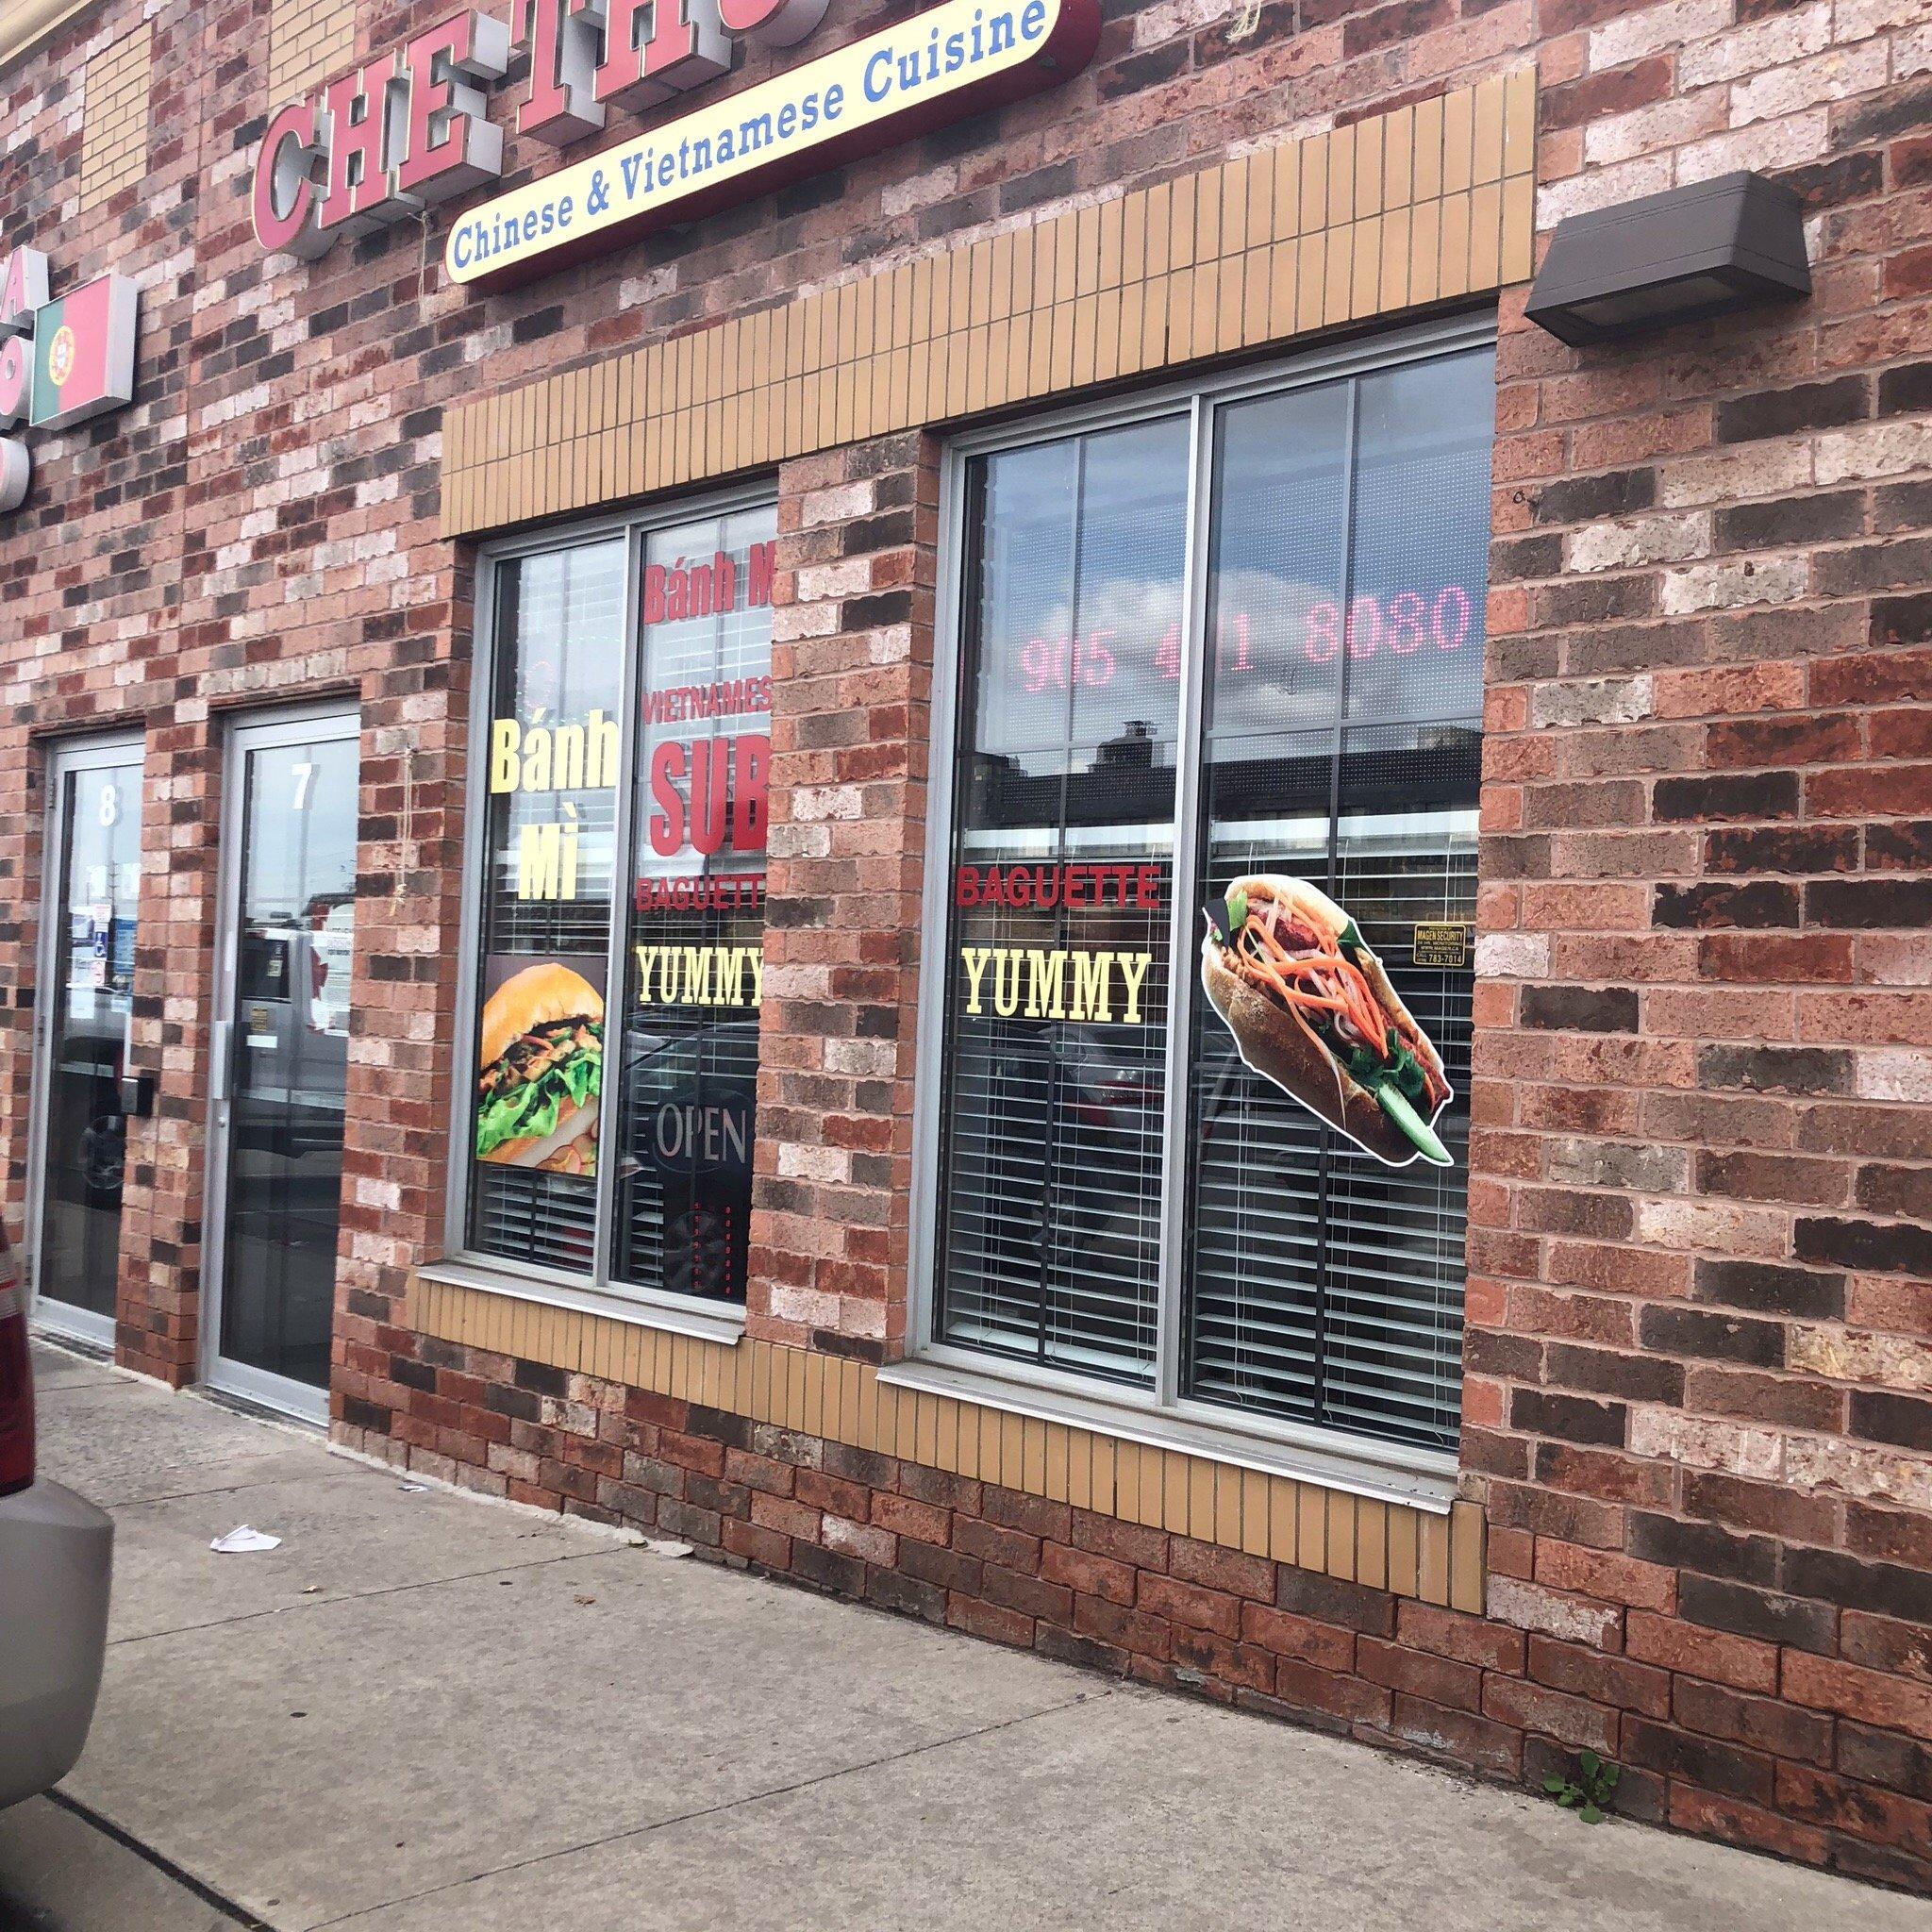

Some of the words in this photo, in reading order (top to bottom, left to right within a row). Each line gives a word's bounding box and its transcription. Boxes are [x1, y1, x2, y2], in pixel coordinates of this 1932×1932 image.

[252, 8, 473, 251] CHE
[509, 0, 782, 135] TH
[452, 193, 575, 270] Chinese
[586, 170, 610, 216] &
[621, 83, 845, 203] Vietnamese
[862, 0, 1046, 104] Cuisine
[643, 550, 736, 625] Bánh
[1021, 629, 1116, 693] 905
[1304, 586, 1472, 663] 8080
[291, 762, 314, 810] 7
[490, 708, 619, 794] Bánh
[99, 785, 117, 826] 8
[649, 734, 772, 857] SUB
[517, 801, 579, 901] Mì
[956, 865, 1161, 909] BAGUETTE
[1437, 930, 1464, 941] SECURITY
[636, 945, 765, 1008] YUMMY
[960, 947, 1153, 1024] YUMMY
[657, 1102, 746, 1164] OPEN
